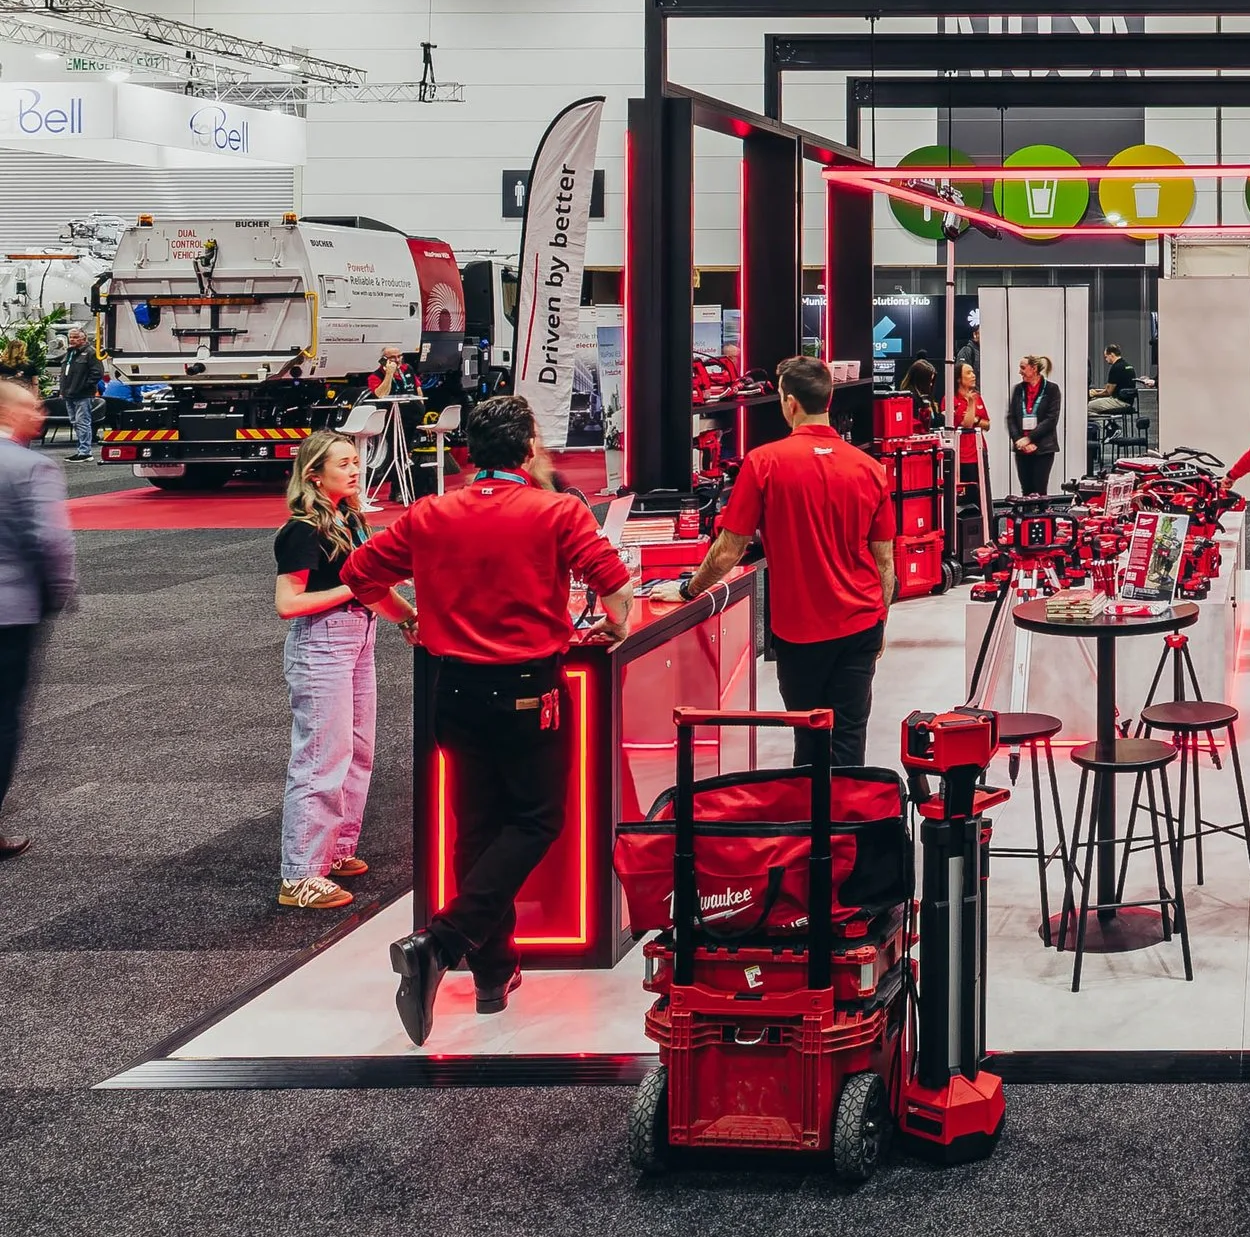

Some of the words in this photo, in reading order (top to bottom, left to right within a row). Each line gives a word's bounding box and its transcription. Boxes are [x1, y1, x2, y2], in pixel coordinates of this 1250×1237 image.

[549, 163, 576, 248] better
[178, 230, 197, 238] DUAL
[171, 240, 203, 249] CONTROL
[310, 239, 334, 248] BUCHER
[173, 251, 202, 260] VEHICLE
[347, 263, 375, 273] Powerful
[545, 256, 569, 288] by
[350, 276, 374, 286] Reliable
[381, 278, 412, 288] Productive
[801, 297, 828, 306] Munic
[873, 296, 909, 306] olutions
[911, 296, 930, 306] Hub
[538, 299, 561, 384] Driven
